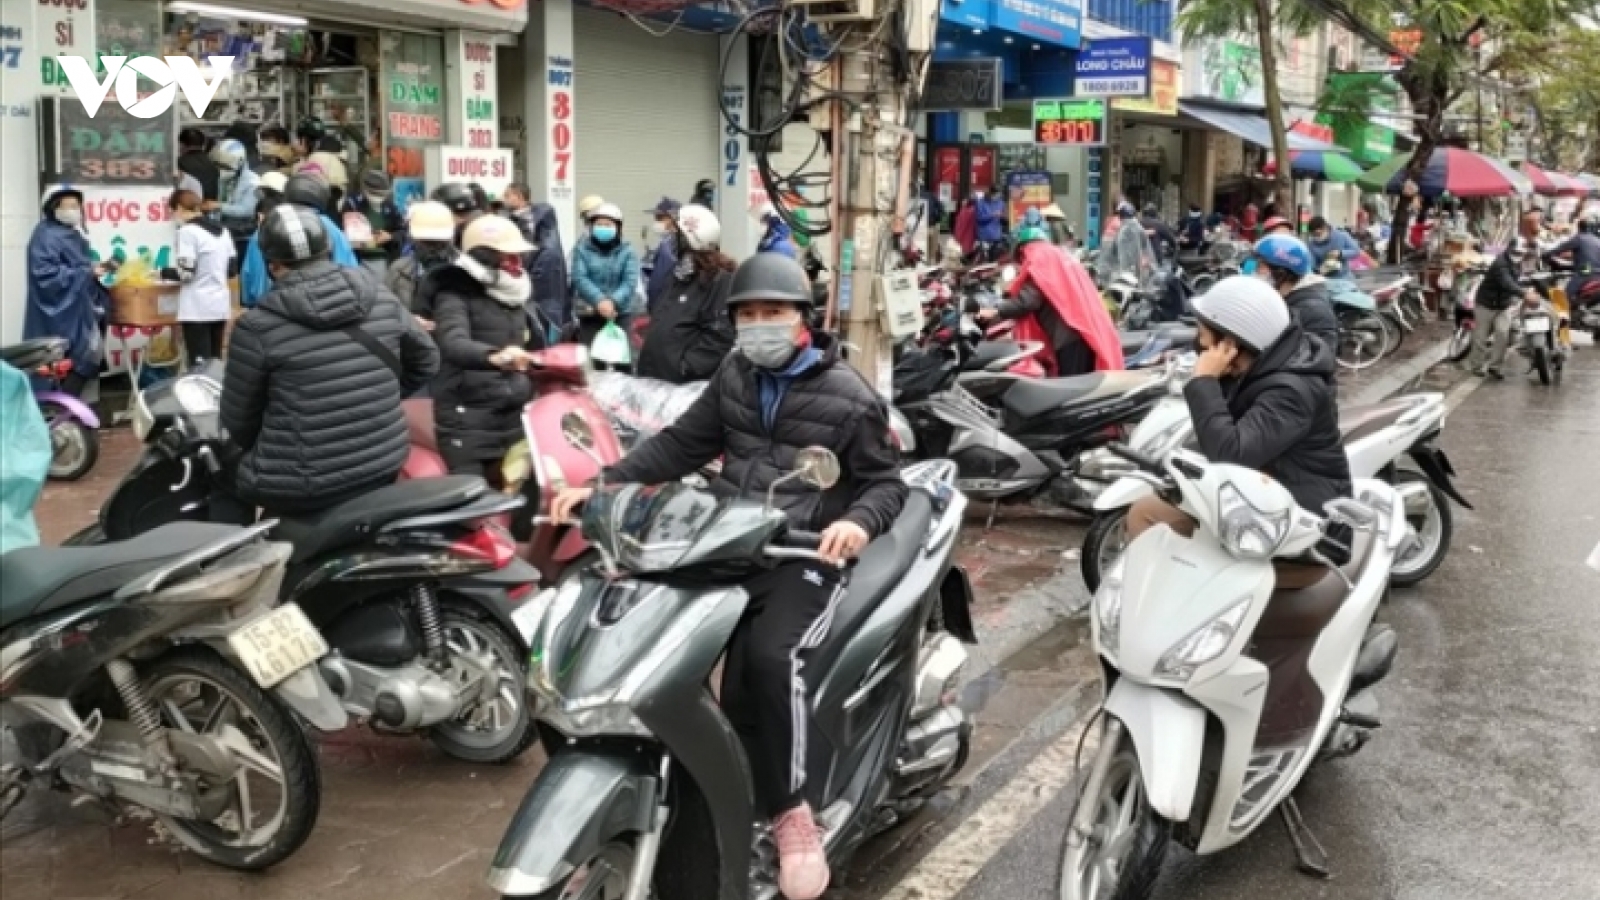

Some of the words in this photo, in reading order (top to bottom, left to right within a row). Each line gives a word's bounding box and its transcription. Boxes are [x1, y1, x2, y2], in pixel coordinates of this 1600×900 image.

[1076, 59, 1108, 72] LONG
[1110, 56, 1146, 71] CHÂU
[388, 112, 442, 138] TRANG
